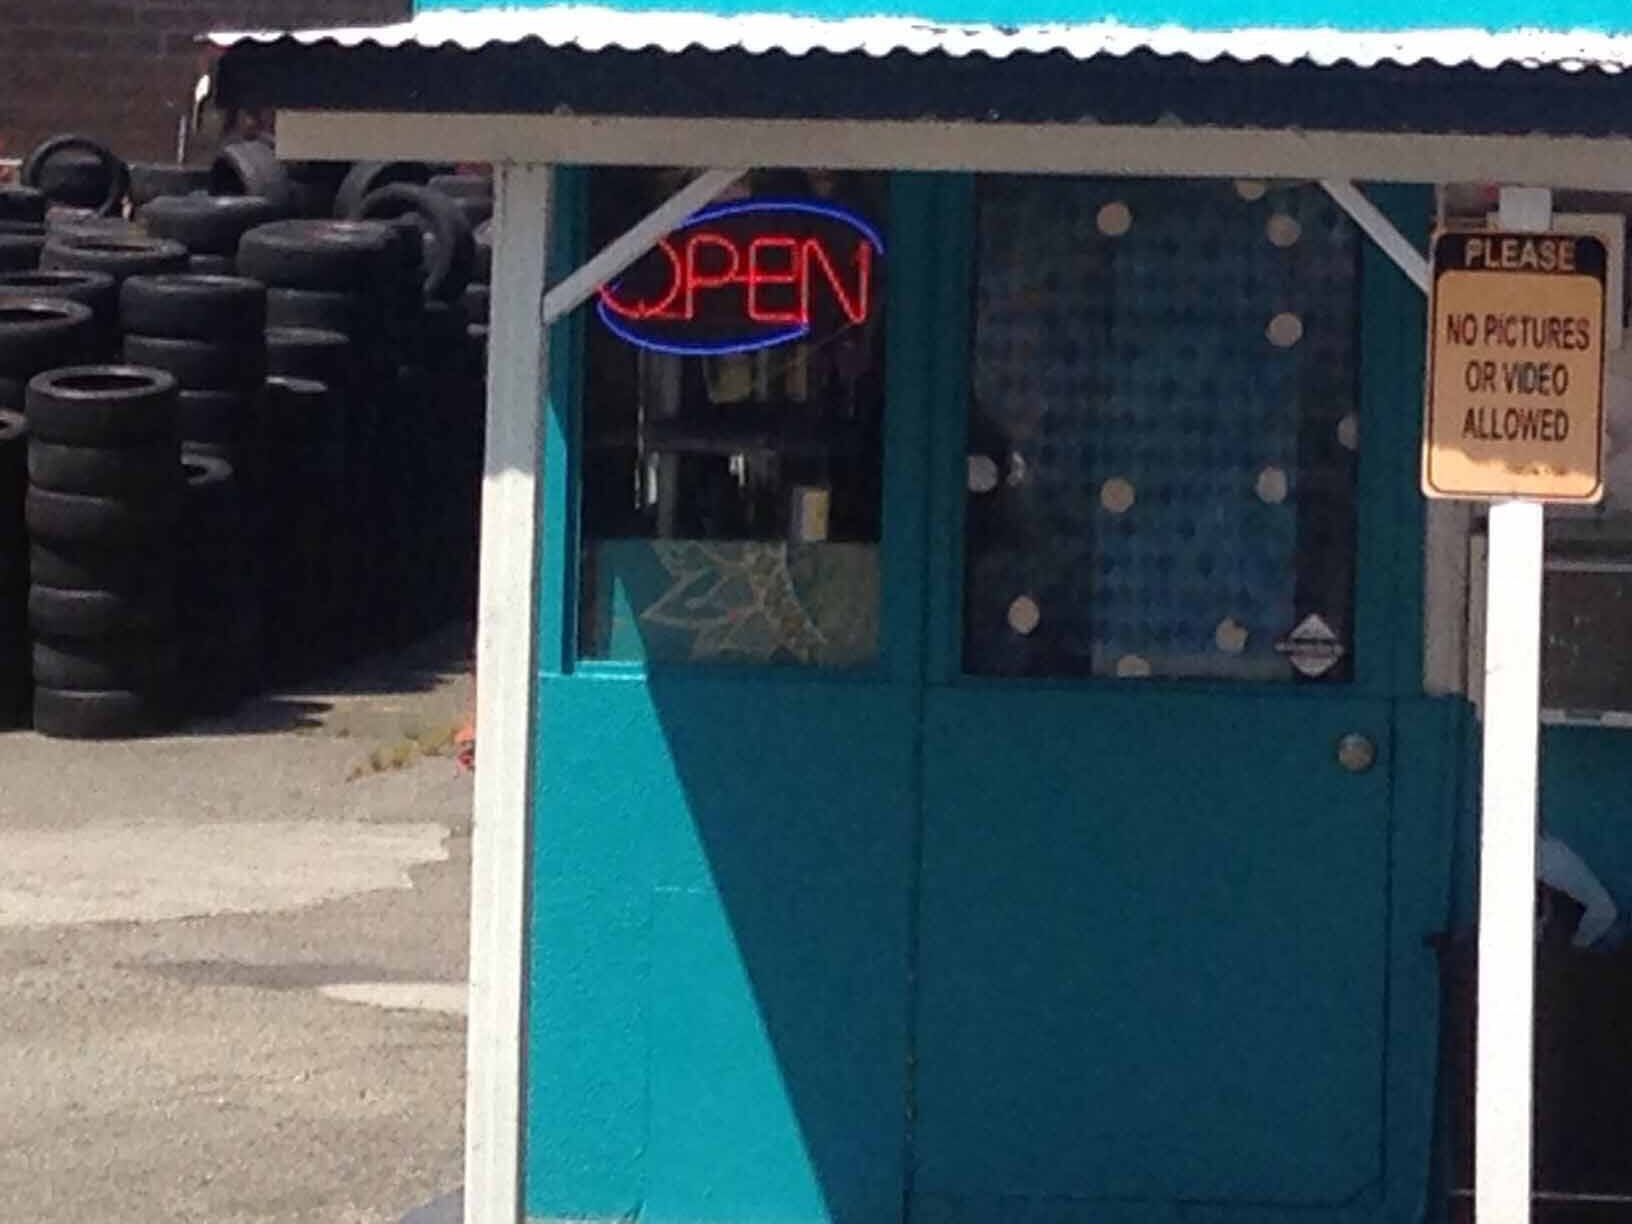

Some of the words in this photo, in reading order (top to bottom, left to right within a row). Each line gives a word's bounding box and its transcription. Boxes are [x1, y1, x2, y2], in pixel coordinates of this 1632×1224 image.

[1464, 238, 1577, 270] PLEASE
[597, 234, 870, 324] OPEN
[1446, 314, 1478, 344] NO
[1483, 315, 1590, 351] PICTURES
[1464, 360, 1496, 393] OR
[1502, 360, 1570, 396] VIDEO
[1462, 407, 1570, 442] ALLOWED
